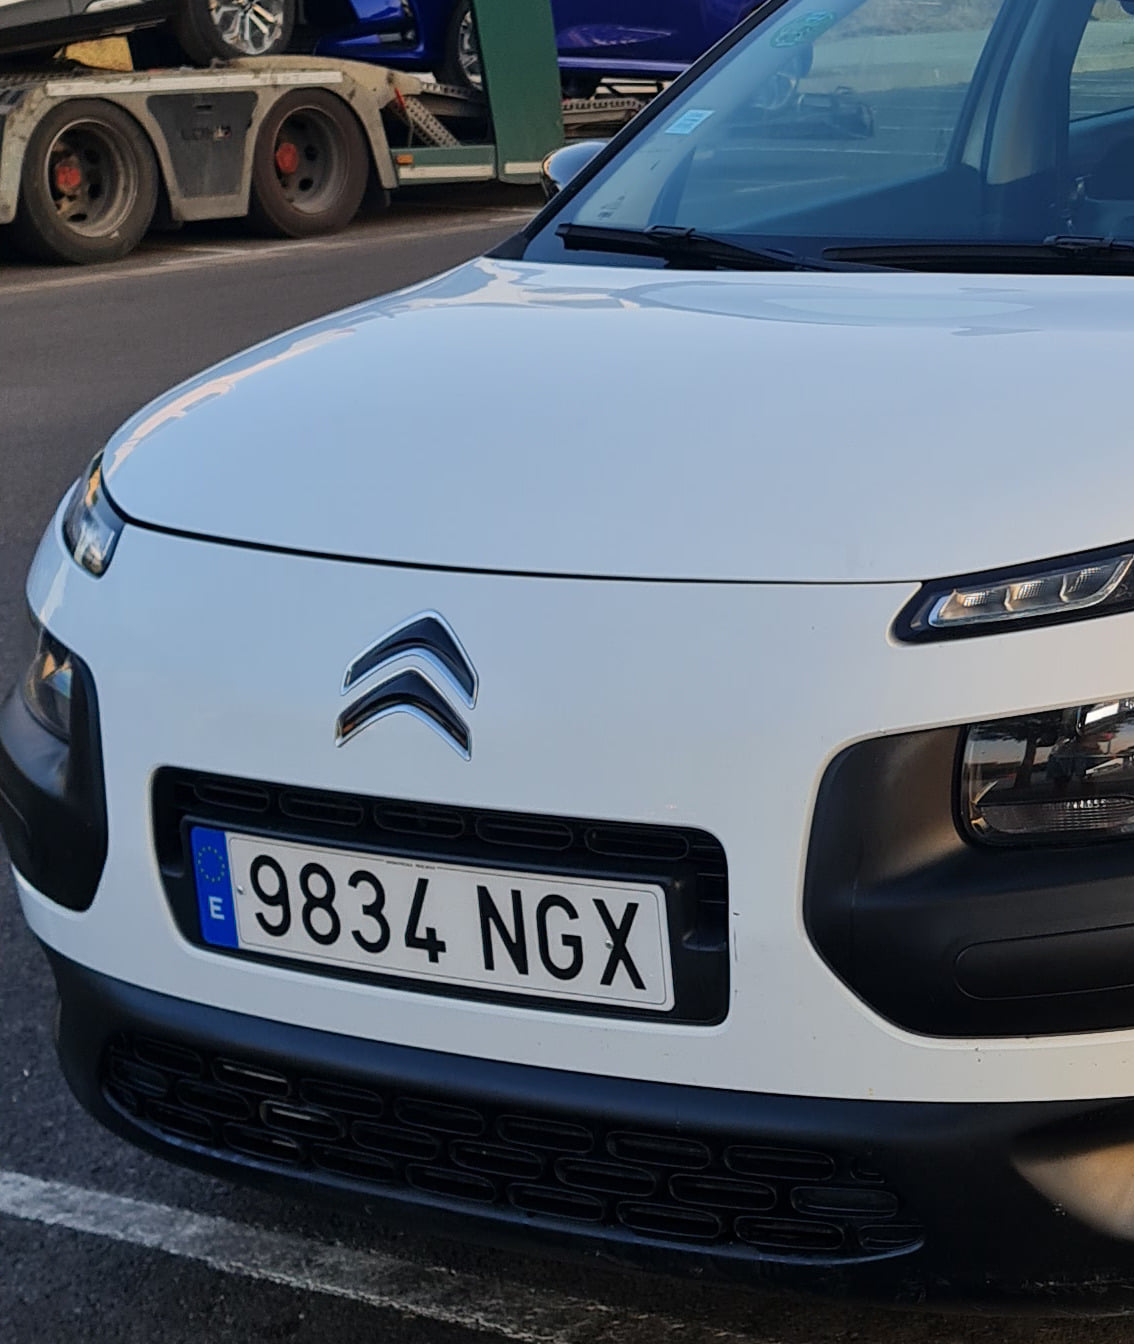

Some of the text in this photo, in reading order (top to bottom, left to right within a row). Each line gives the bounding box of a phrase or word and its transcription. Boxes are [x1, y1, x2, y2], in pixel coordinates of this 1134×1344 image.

[209, 895, 226, 921] E
[250, 854, 648, 991] 9834 NGX
